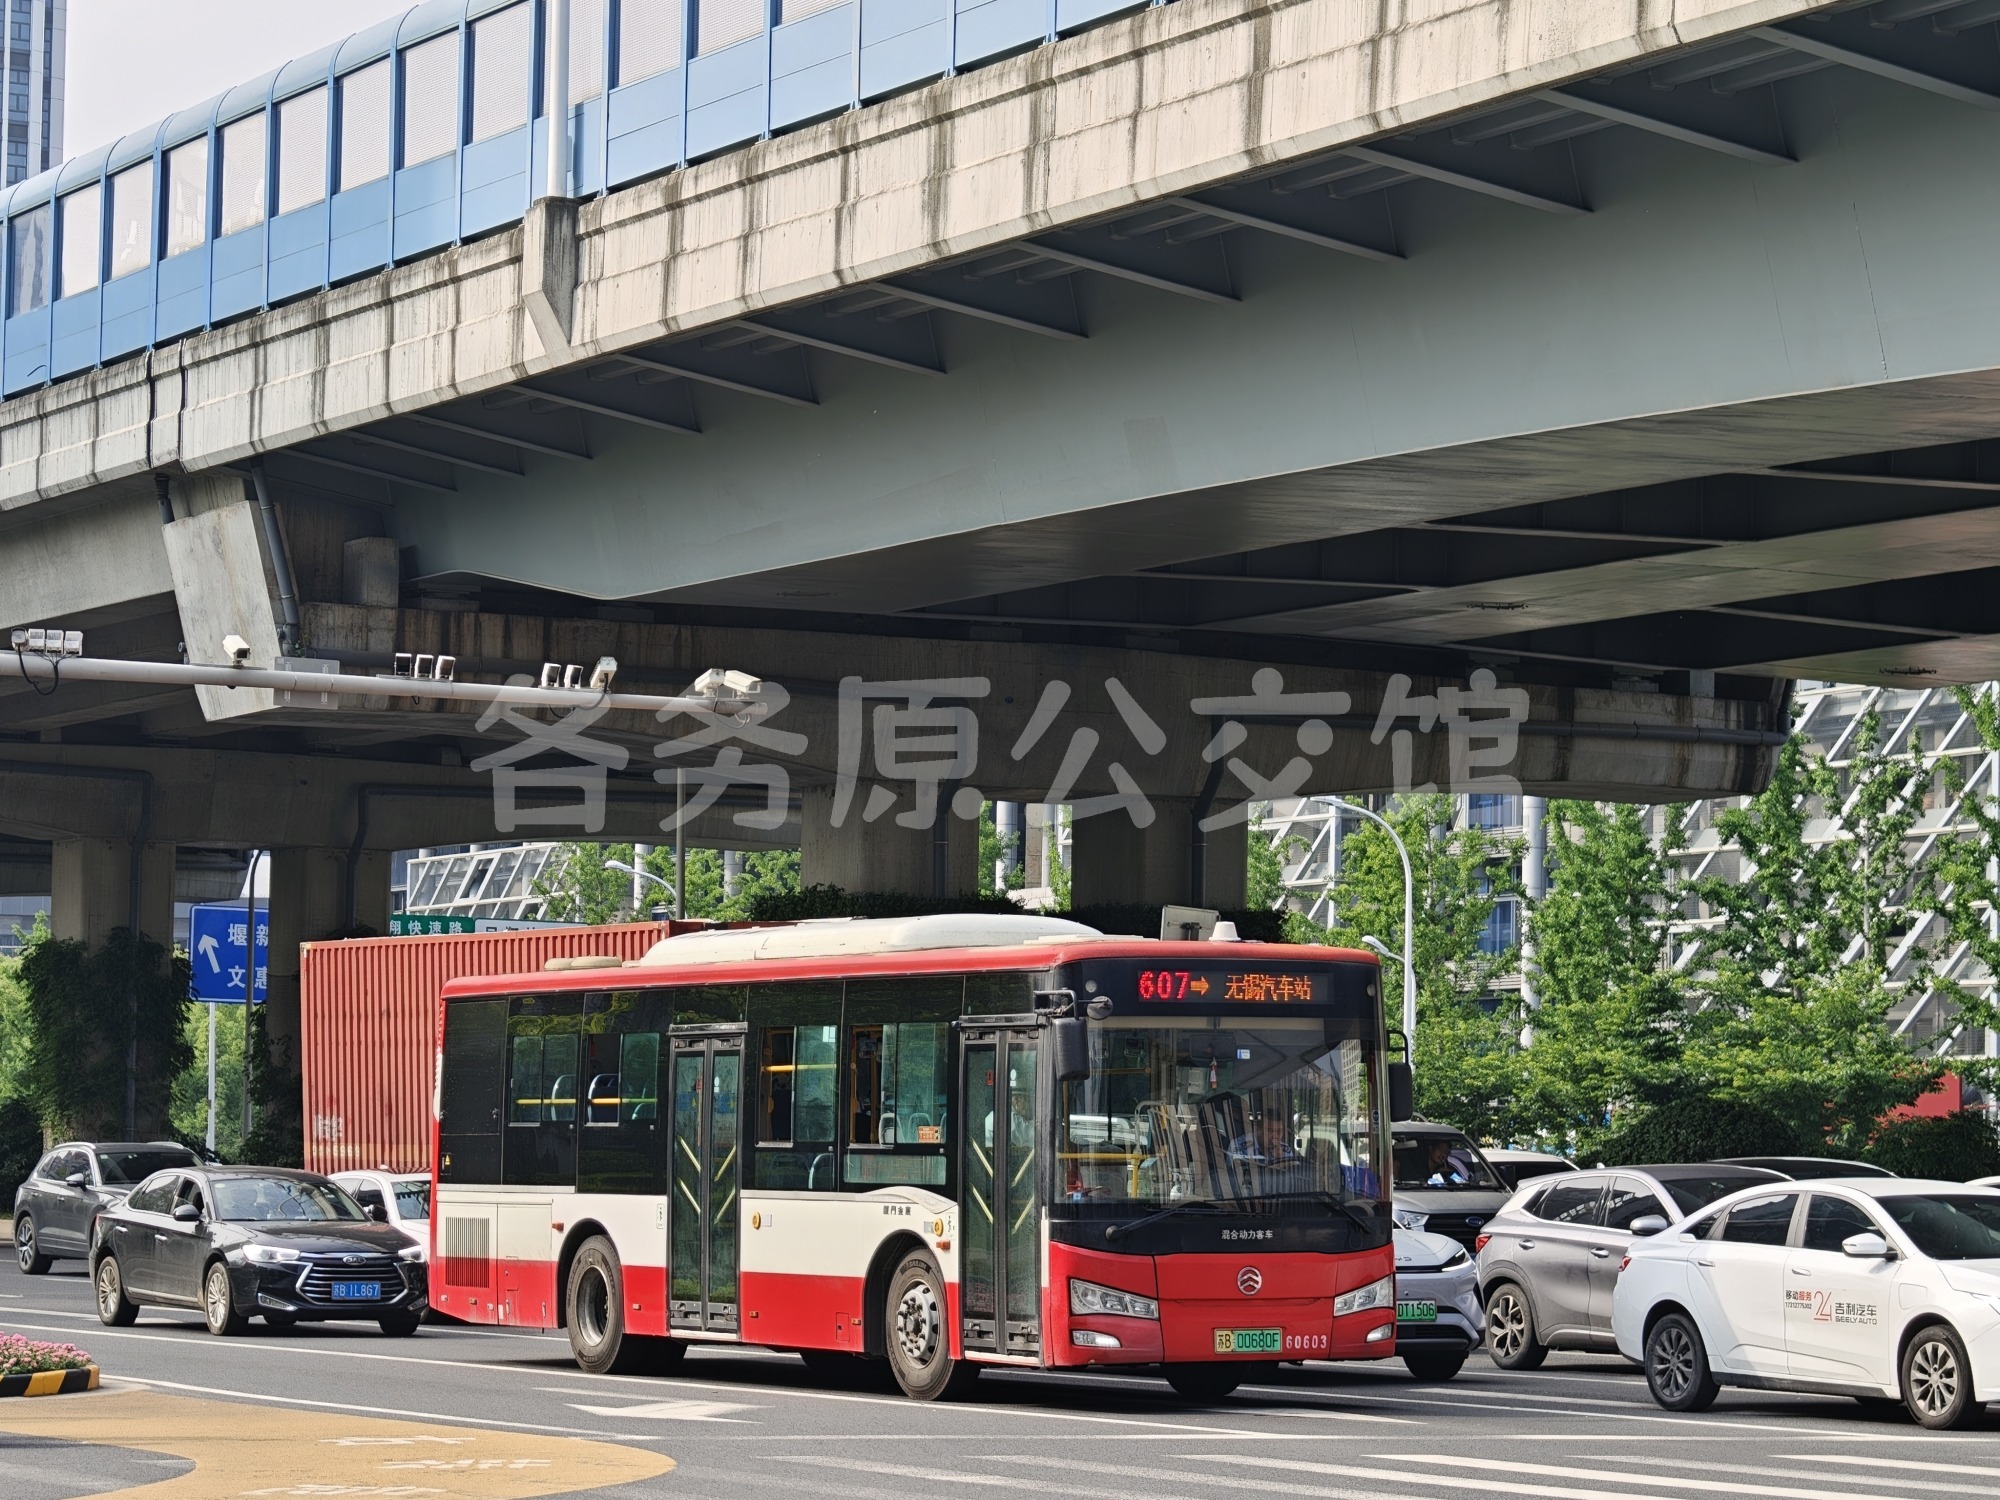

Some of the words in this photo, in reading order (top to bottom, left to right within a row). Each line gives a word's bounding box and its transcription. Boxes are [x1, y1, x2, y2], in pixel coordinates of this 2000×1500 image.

[1139, 971, 1189, 999] 607
[1224, 974, 1312, 1001] 无锡汽车站
[1221, 1229, 1274, 1240] 混合动力客车
[1785, 1290, 1812, 1302] 移动服务
[1397, 1302, 1435, 1317] DT1506
[1834, 1302, 1877, 1317] 吉利汽车
[1286, 1334, 1327, 1349] 60603
